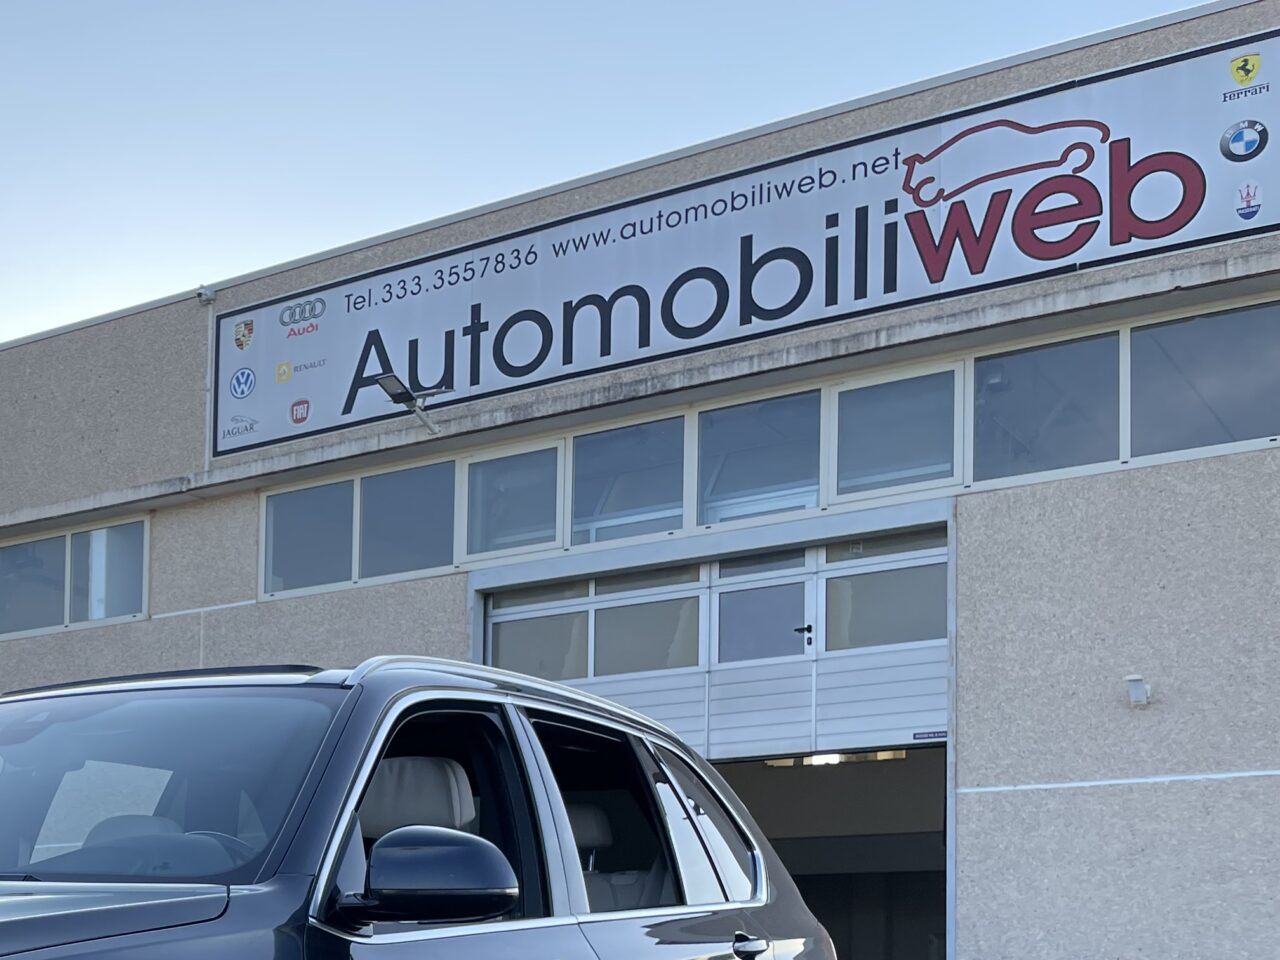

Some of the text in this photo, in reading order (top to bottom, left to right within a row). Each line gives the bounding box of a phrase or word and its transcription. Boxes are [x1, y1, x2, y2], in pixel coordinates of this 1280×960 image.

[1222, 82, 1270, 102] Ferrari
[344, 147, 902, 313] Tel.333.3557836 www.automobiliweb.net
[341, 137, 1207, 416] Automobiliweb
[287, 322, 319, 339] Audi
[293, 359, 326, 373] RENAULT
[293, 403, 309, 420] FIAT
[222, 423, 255, 440] JAGUAR
